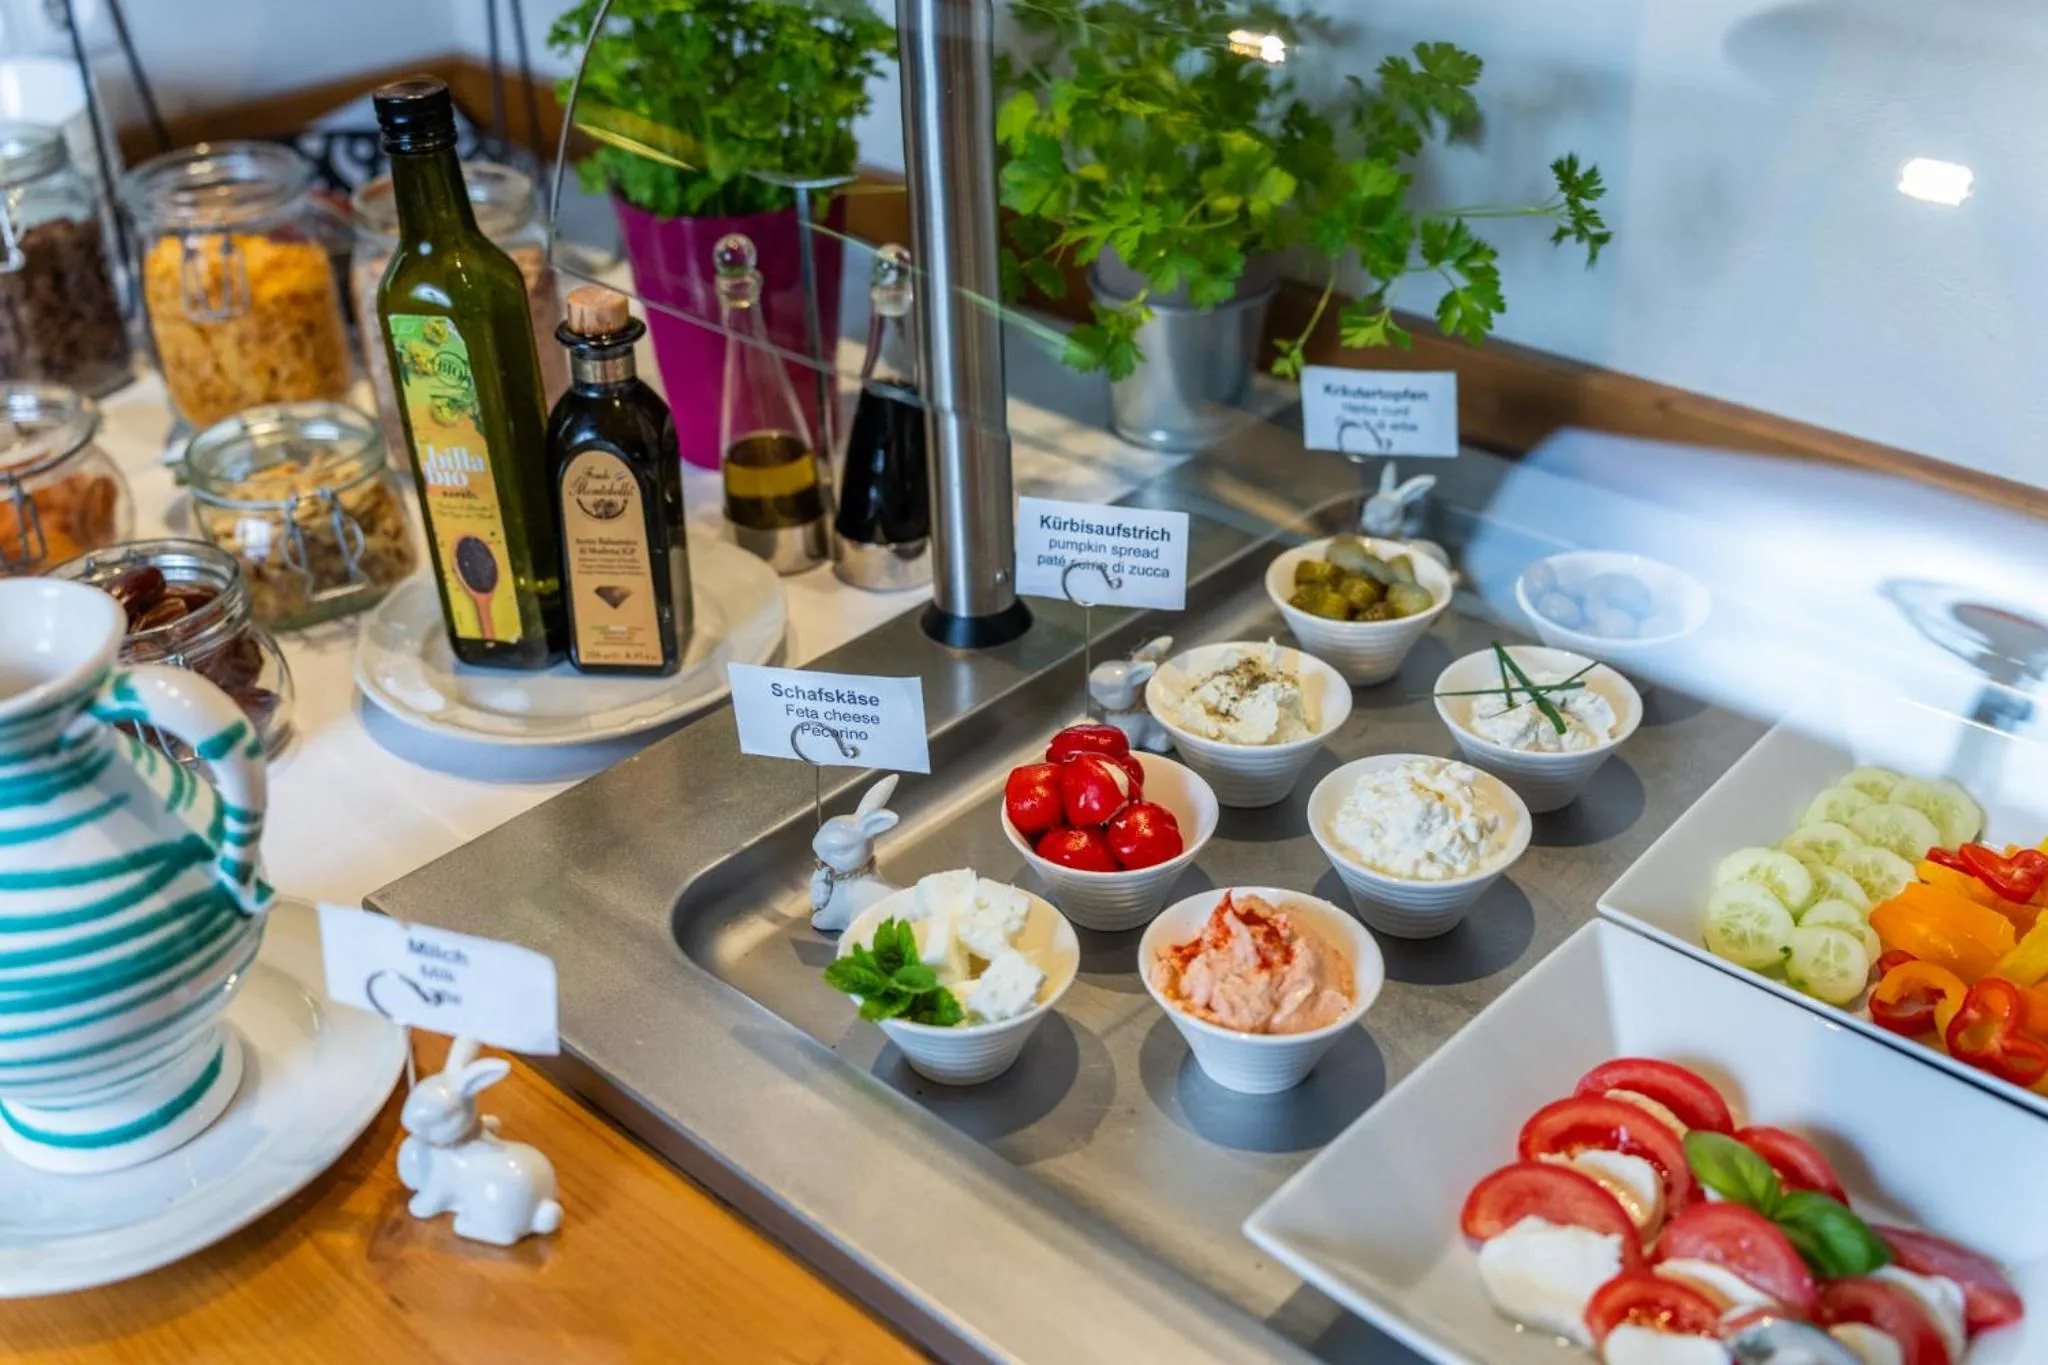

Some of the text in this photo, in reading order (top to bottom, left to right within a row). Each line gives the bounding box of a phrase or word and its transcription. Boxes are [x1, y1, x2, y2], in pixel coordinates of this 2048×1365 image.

[1039, 514, 1171, 542] Kürbisaufstrich
[1048, 537, 1160, 560] pumpkin spread
[1036, 553, 1066, 568] paté
[1112, 561, 1125, 575] di
[1128, 565, 1170, 579] zucca
[770, 682, 881, 707] Schafskäse
[785, 703, 881, 725] Feta cheese
[407, 936, 468, 966] Milch
